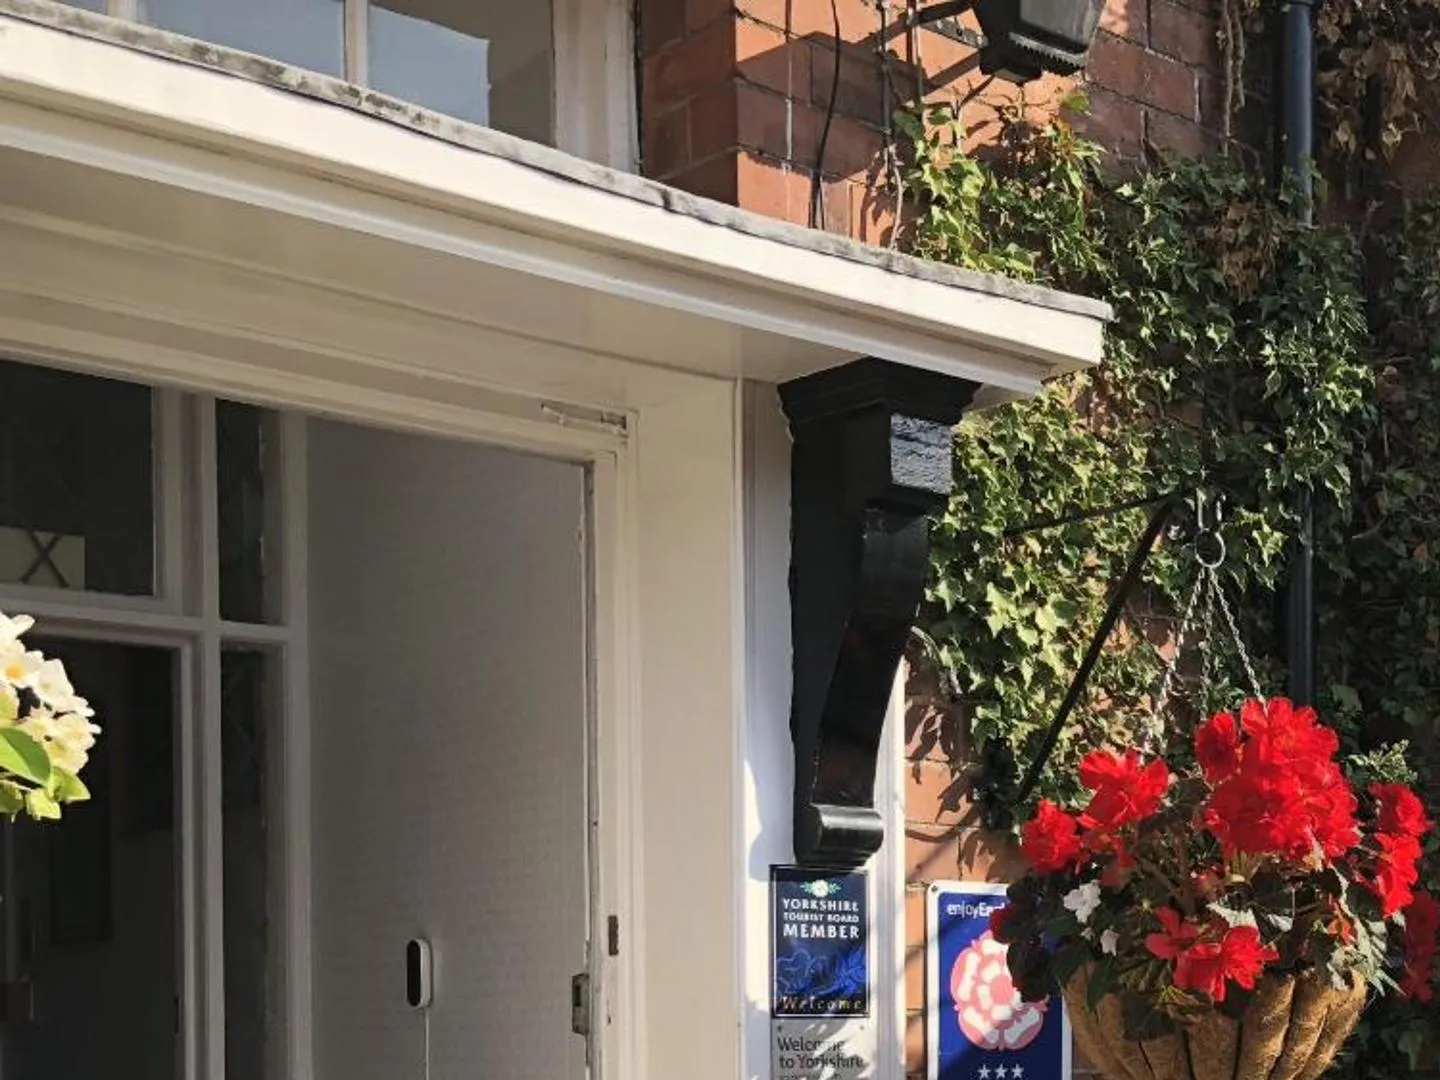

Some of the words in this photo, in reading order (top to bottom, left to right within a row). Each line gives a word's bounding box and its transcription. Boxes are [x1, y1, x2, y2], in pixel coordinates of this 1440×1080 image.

[782, 898, 859, 912] YORKSHIRE
[783, 912, 824, 921] TOURIST
[827, 914, 860, 923] BOARD
[783, 923, 860, 939] MEMBER
[782, 996, 863, 1010] Welcome
[779, 1054, 795, 1069] to
[795, 1052, 864, 1070] Yorkshire
